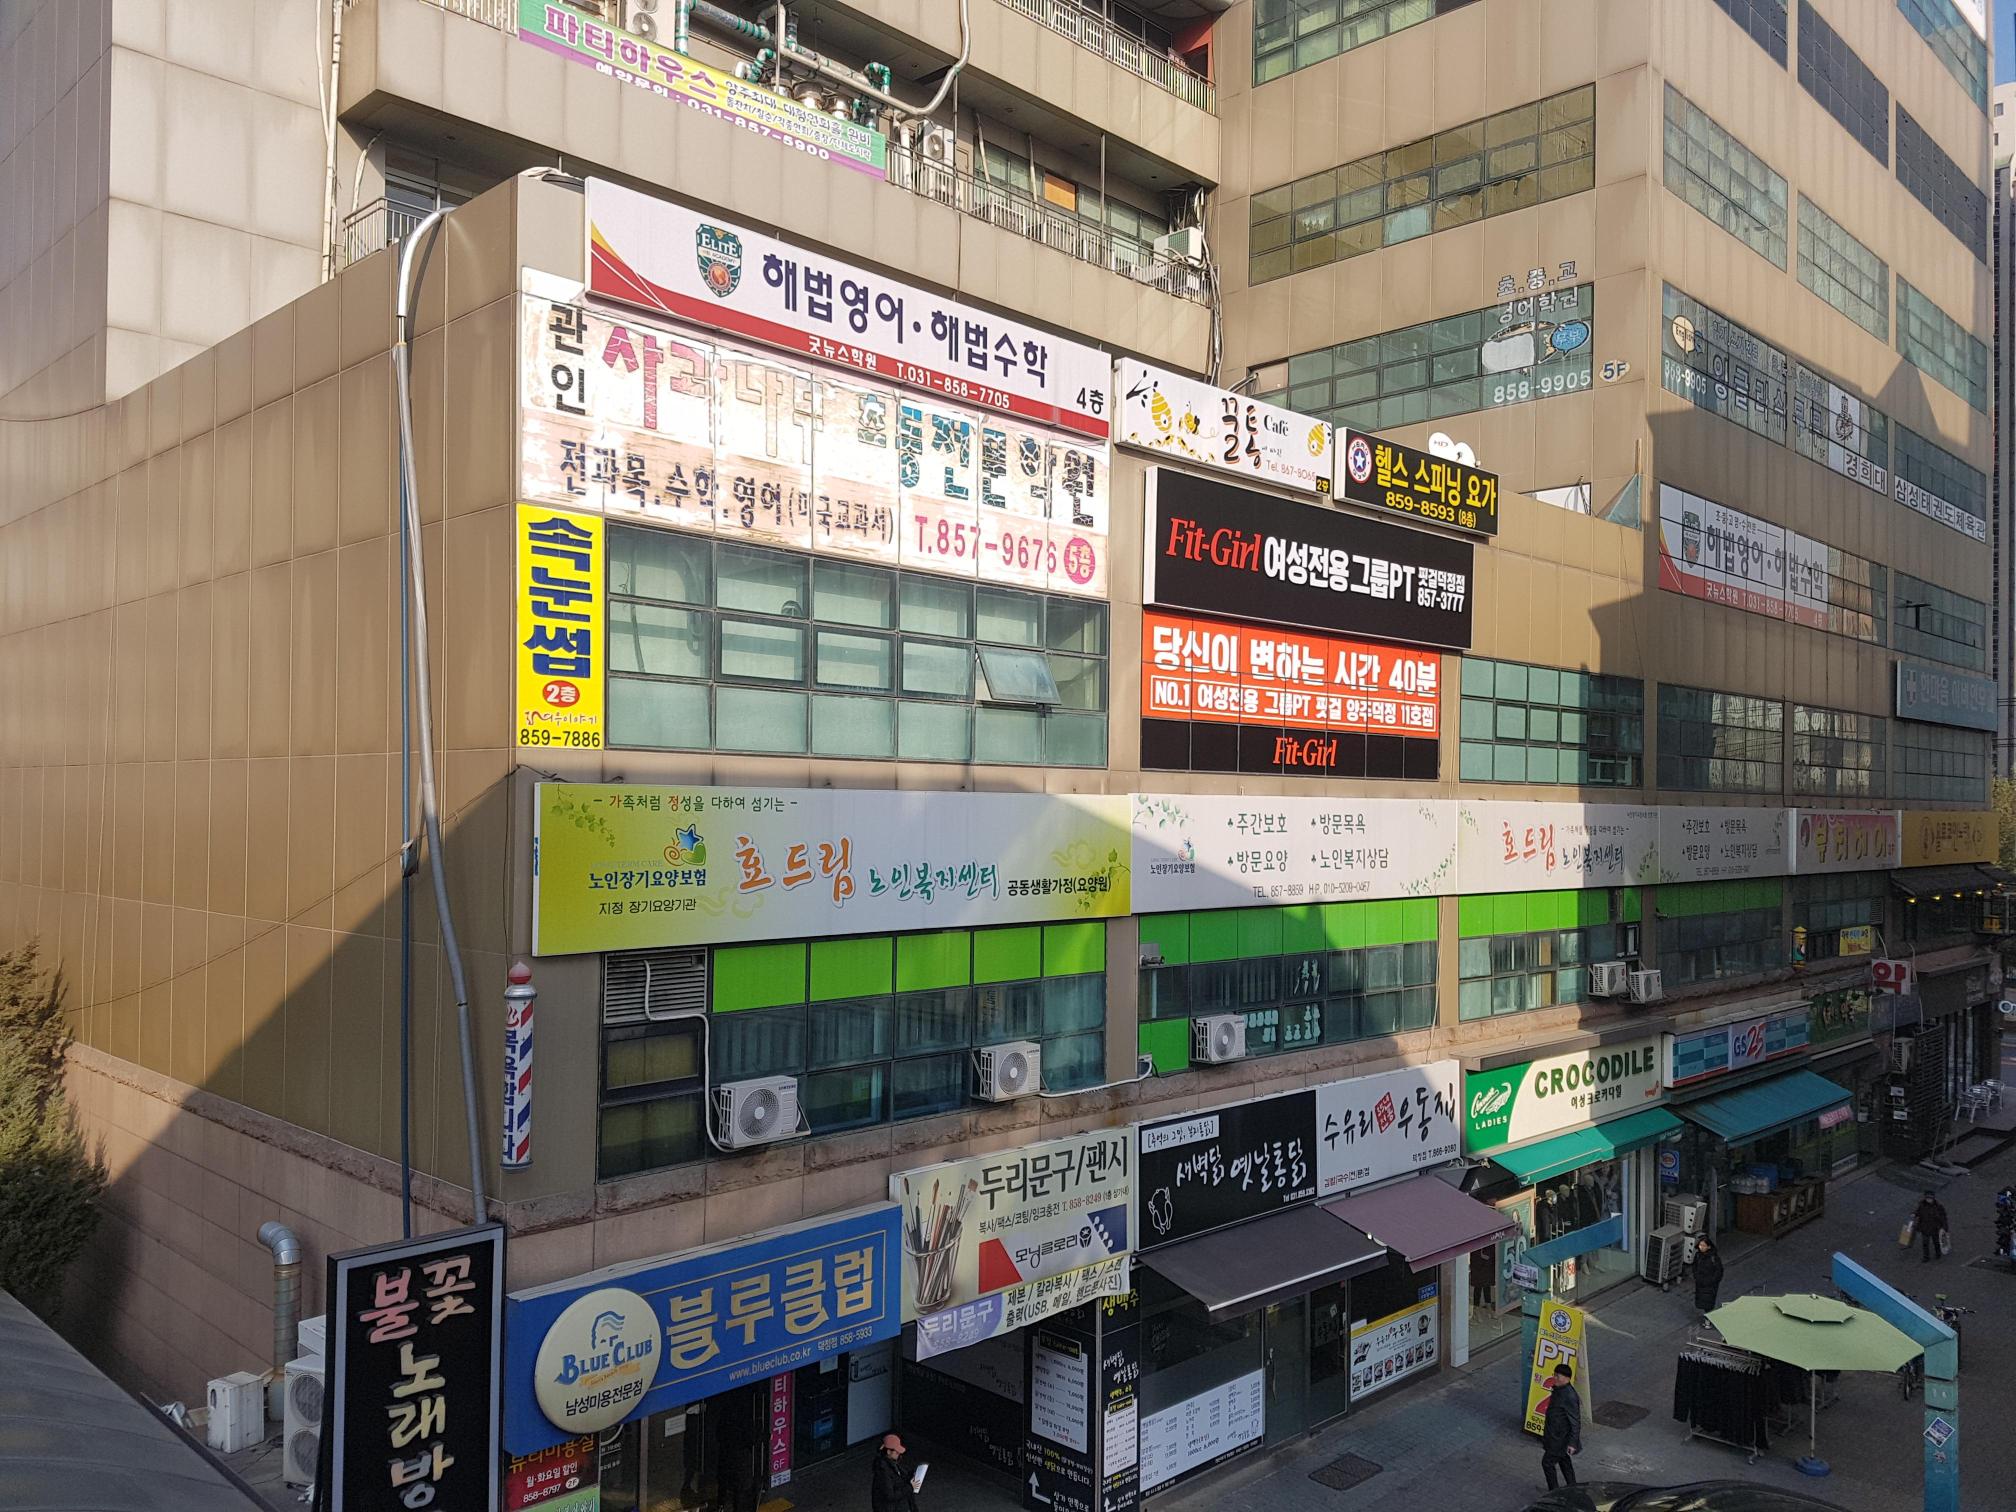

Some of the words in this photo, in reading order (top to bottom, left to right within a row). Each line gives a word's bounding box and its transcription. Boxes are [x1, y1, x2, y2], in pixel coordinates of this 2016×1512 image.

[543, 6, 718, 100] 파티하우스
[595, 61, 669, 99] 예약문의
[686, 97, 830, 161] 031-857-5900
[725, 80, 777, 110] 양주최대
[783, 102, 842, 136] 대형연회홀
[847, 127, 872, 147] 완비
[701, 232, 738, 257] ELITE
[1497, 260, 1578, 298] 초.중.고
[1499, 286, 1578, 324] 영어학원
[549, 304, 588, 416] 관인
[808, 334, 878, 373] 굿뉴스학원
[896, 361, 1010, 410] T.031-858-7705
[1075, 386, 1106, 416] 4층
[1603, 361, 1627, 380] 5F
[1493, 369, 1592, 403] 858-9905
[1263, 414, 1290, 437] Café
[1281, 463, 1316, 482] 867-8065
[1375, 444, 1409, 489] 헬스
[1413, 459, 1462, 507] 스피닝
[1465, 474, 1497, 517] 요가
[1845, 452, 1886, 497] 경희대
[1385, 491, 1456, 523] 859-8593
[1457, 508, 1478, 529] (8층)
[1895, 478, 1986, 541] 삼성태권도체육관
[914, 515, 1057, 574] T.857-9676
[1165, 517, 1262, 572] Fit-Girl
[1417, 566, 1466, 594] 핏걸덕정점
[1417, 591, 1465, 613] 857-3777
[1152, 624, 1238, 677] 당신이
[1250, 639, 1325, 686] 변하는
[1334, 650, 1381, 692] 시간
[1388, 657, 1437, 697] 40분
[545, 684, 576, 703] 2층
[1154, 680, 1191, 707] NO.1
[1197, 686, 1259, 714] 여성전용
[1264, 692, 1310, 718] 그룹PT
[1315, 696, 1342, 721] 핏걸
[1346, 701, 1397, 724] 양주덕정
[1400, 703, 1434, 729] 11호점
[520, 728, 600, 748] 859-7886
[1272, 736, 1337, 768] Fit-Girl
[609, 794, 662, 812] 가족처럼
[667, 795, 705, 812] 정성을
[711, 796, 746, 811] 다하여
[751, 797, 786, 813] 섬기는
[1236, 812, 1288, 835] 주간보호
[1319, 812, 1367, 836] 방문목욕
[1685, 818, 1711, 836] 주간보호
[1724, 818, 1748, 835] 방문목욕
[1150, 862, 1196, 875] 노인장기요양보험
[1236, 849, 1288, 874] 방문요양
[1319, 848, 1390, 871] 노인복지상담
[1562, 847, 1625, 873] 노인복지센터
[1686, 844, 1711, 861] 방문요양
[1723, 843, 1758, 860] 노인복지상담
[588, 867, 707, 891] 노인장기요양보험
[868, 861, 999, 902] 노인복지센터
[1007, 875, 1112, 897] 공동생활가정(요양원)
[1252, 886, 1269, 898] TEL.
[599, 900, 624, 916] 지정
[629, 898, 697, 914] 장기요양기관
[1873, 961, 1907, 995] 약
[1733, 1023, 1766, 1059] GS25
[1534, 1046, 1655, 1099] CROCODILE
[1570, 1094, 1586, 1110] 여성
[1587, 1084, 1623, 1106] 크로커다일
[1324, 1108, 1375, 1150] 수유리
[1397, 1083, 1456, 1143] 우동집
[1475, 1115, 1508, 1131] LADIES
[978, 1135, 1128, 1211] 두리문구/팬시
[1176, 1145, 1226, 1188] 새벽닭
[1230, 1137, 1307, 1194] 옛날통닭
[1015, 1233, 1078, 1269] 모닝글로리
[359, 1255, 476, 1344] 불꽃
[1007, 1289, 1026, 1306] 제본
[1036, 1275, 1073, 1298] 칼라복사
[1081, 1268, 1098, 1287] 팩스
[1102, 1289, 1140, 1317] 생맥주
[666, 1246, 875, 1371] 블루클럽
[921, 1299, 994, 1335] 두리문구
[553, 1353, 610, 1386] BLUE
[612, 1338, 653, 1367] CLUB
[728, 1346, 811, 1383] www.blueclub.co.kr
[817, 1334, 838, 1353] 덕정점
[839, 1325, 873, 1347] 858-5933
[1103, 1350, 1125, 1371] 새벽닭
[1537, 1338, 1576, 1368] PT
[565, 1378, 644, 1417] 남성미용전문점
[387, 1340, 455, 1510] 노래방
[773, 1458, 786, 1470] 6F
[1025, 1439, 1043, 1454] 국내산
[1043, 1447, 1060, 1460] 100%
[523, 1482, 562, 1503] 858-8797
[568, 1479, 578, 1488] 2F
[526, 1467, 561, 1489] 월·화요일
[563, 1461, 578, 1476] 할인
